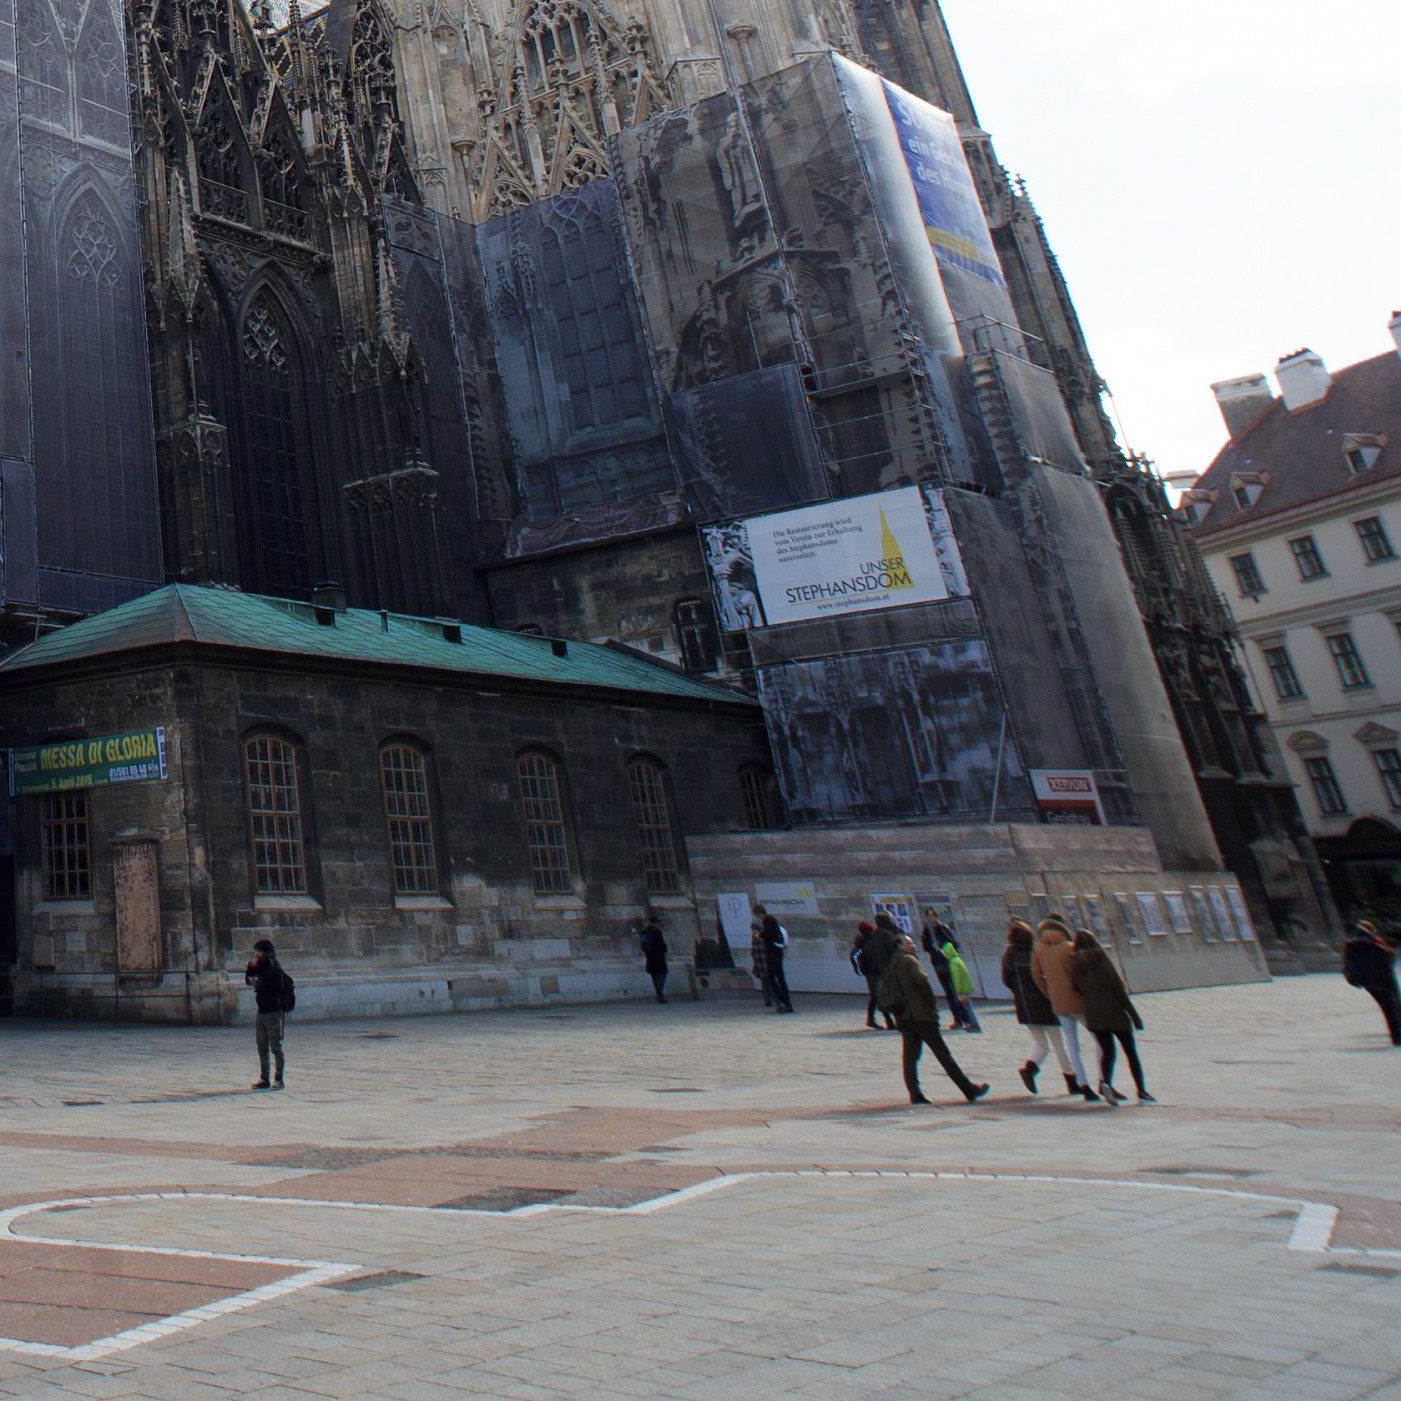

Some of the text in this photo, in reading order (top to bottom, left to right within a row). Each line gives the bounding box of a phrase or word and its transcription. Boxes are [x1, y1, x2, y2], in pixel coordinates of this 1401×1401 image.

[907, 135, 931, 157] ein
[916, 162, 943, 186] des
[772, 516, 853, 538] Die Restaurierung wird
[774, 537, 790, 546] vom
[791, 533, 813, 543] Verein
[827, 524, 863, 537] Erhaltung
[776, 538, 838, 555] des Stephansdoms
[859, 556, 906, 575] UNSER
[786, 571, 912, 603] STEPHANSDOM
[816, 593, 890, 610] www.stephansdom.at
[40, 733, 156, 770] MESSA DI GLORIA
[59, 775, 75, 790] April
[1048, 778, 1090, 791] XERVON
